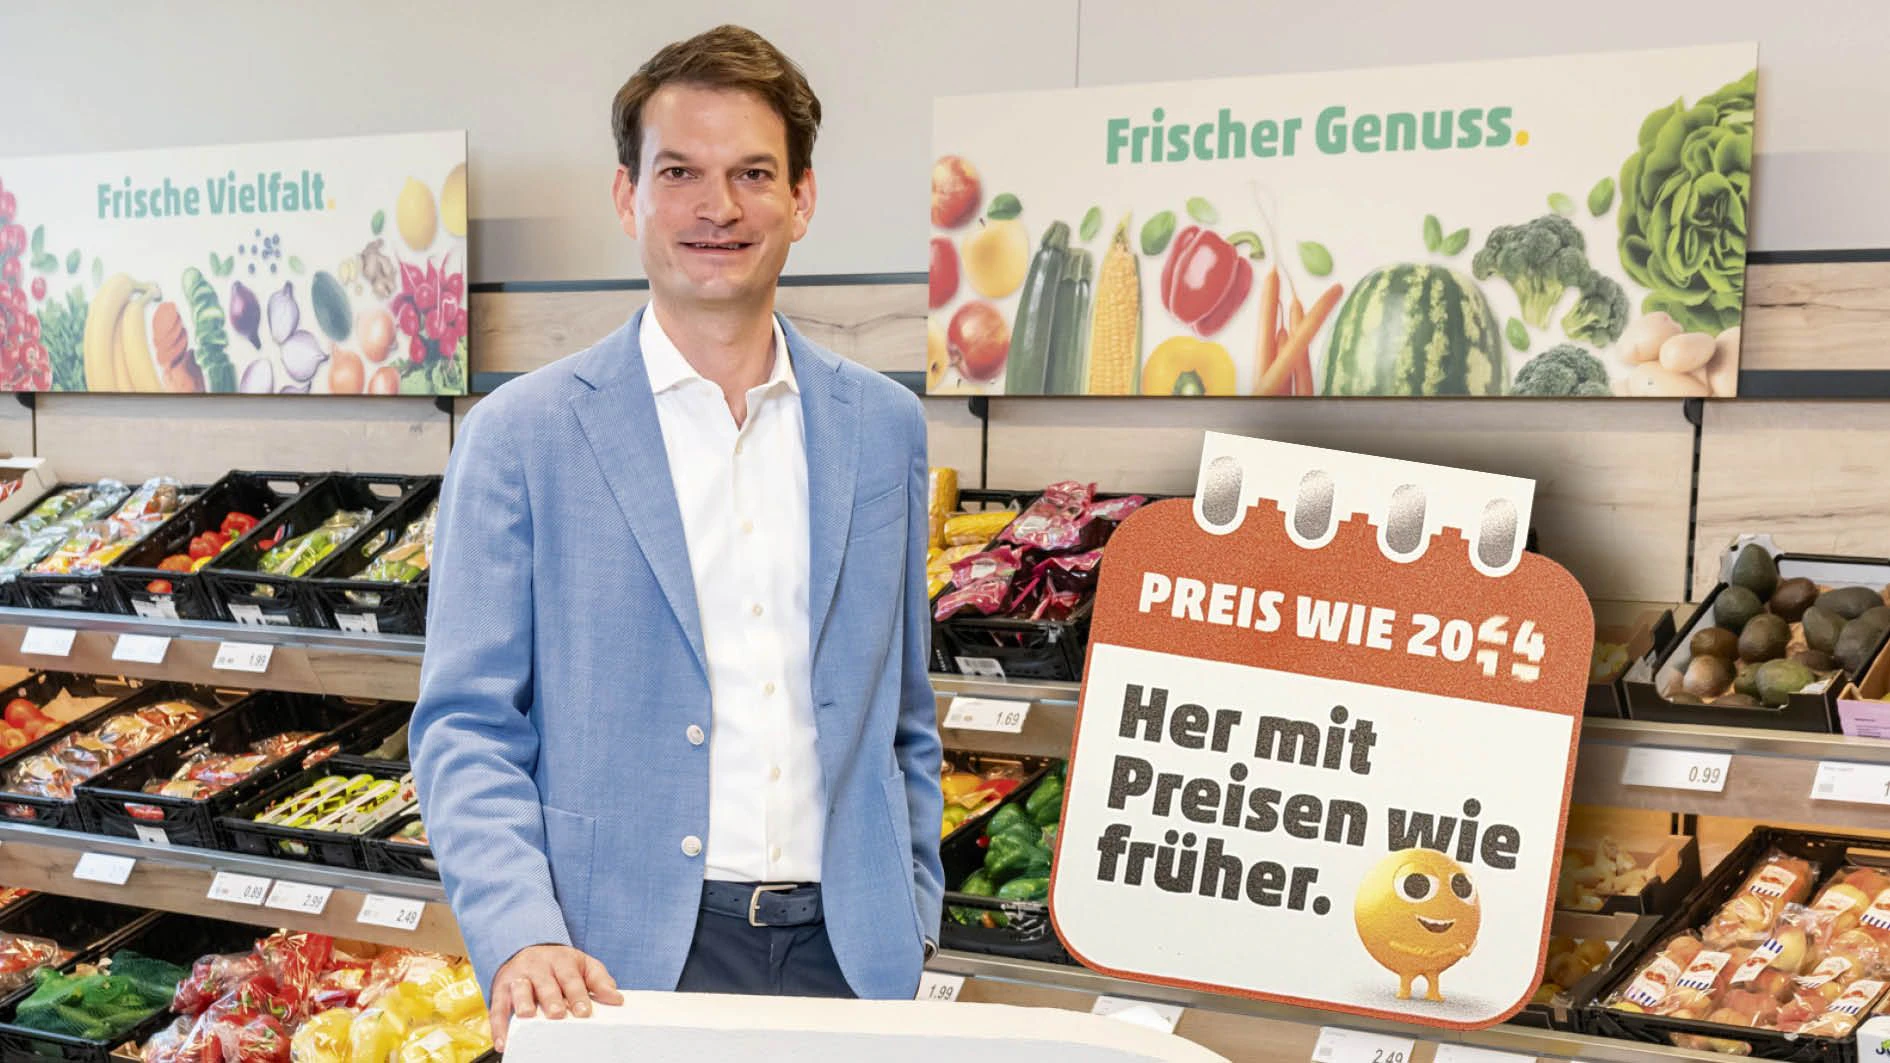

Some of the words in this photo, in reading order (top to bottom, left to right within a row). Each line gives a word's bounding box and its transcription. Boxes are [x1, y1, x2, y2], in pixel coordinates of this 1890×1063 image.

[1105, 106, 1302, 165] Frischer
[1314, 105, 1530, 156] Genuss.
[97, 176, 200, 219] Frische
[207, 169, 336, 215] Vielfalt.
[1137, 571, 1285, 633] PREIS
[1296, 596, 1397, 651] WIE
[995, 711, 1021, 726] 1.69
[1118, 683, 1242, 753] Her
[1254, 704, 1377, 775] mit
[1688, 764, 1722, 785] 0.99
[1107, 754, 1369, 847] Preisen
[1387, 798, 1522, 870] wie
[1096, 822, 1332, 916] früher.
[302, 892, 325, 909] 2.99
[396, 908, 418, 925] 2.49
[928, 984, 954, 1000] 1.99
[1372, 1048, 1404, 1063] 2.49
